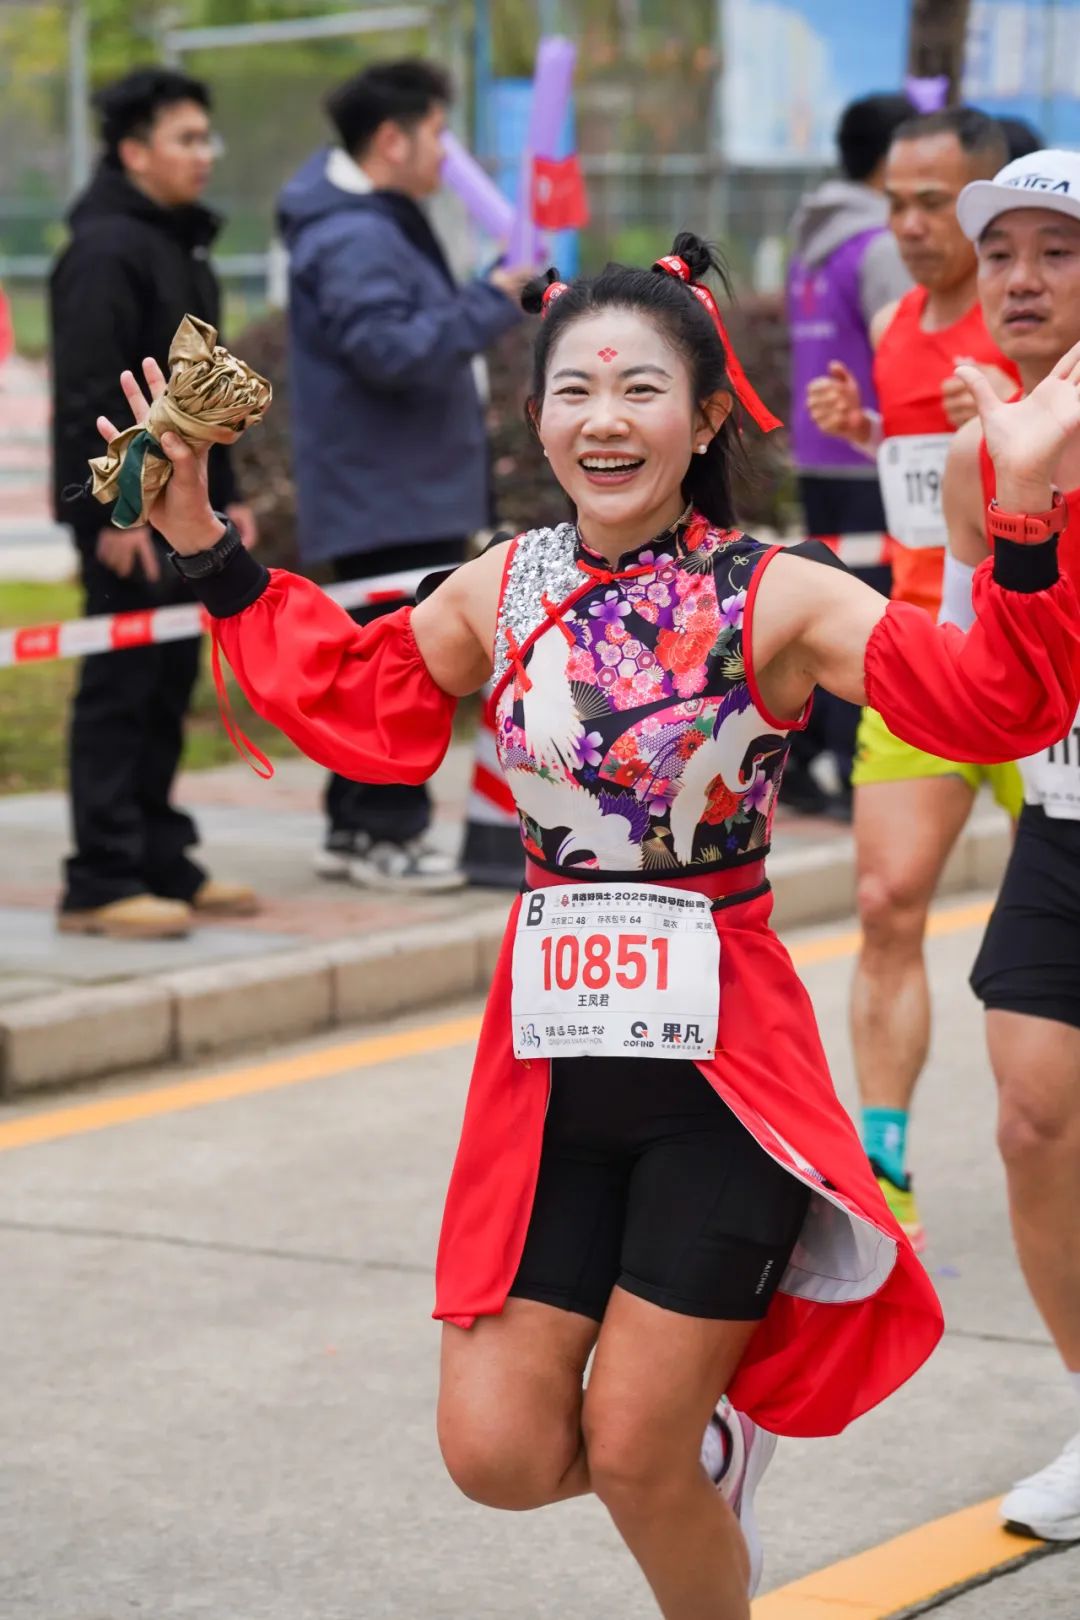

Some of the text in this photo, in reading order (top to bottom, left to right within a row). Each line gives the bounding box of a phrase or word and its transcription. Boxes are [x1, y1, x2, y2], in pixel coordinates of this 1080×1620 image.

[526, 893, 546, 926] B
[575, 916, 586, 924] 48
[629, 915, 642, 924] 64
[541, 934, 669, 991] 10851
[577, 994, 610, 1007] 王凤君
[661, 1022, 704, 1044] 果凡
[623, 1040, 655, 1048] COFIND
